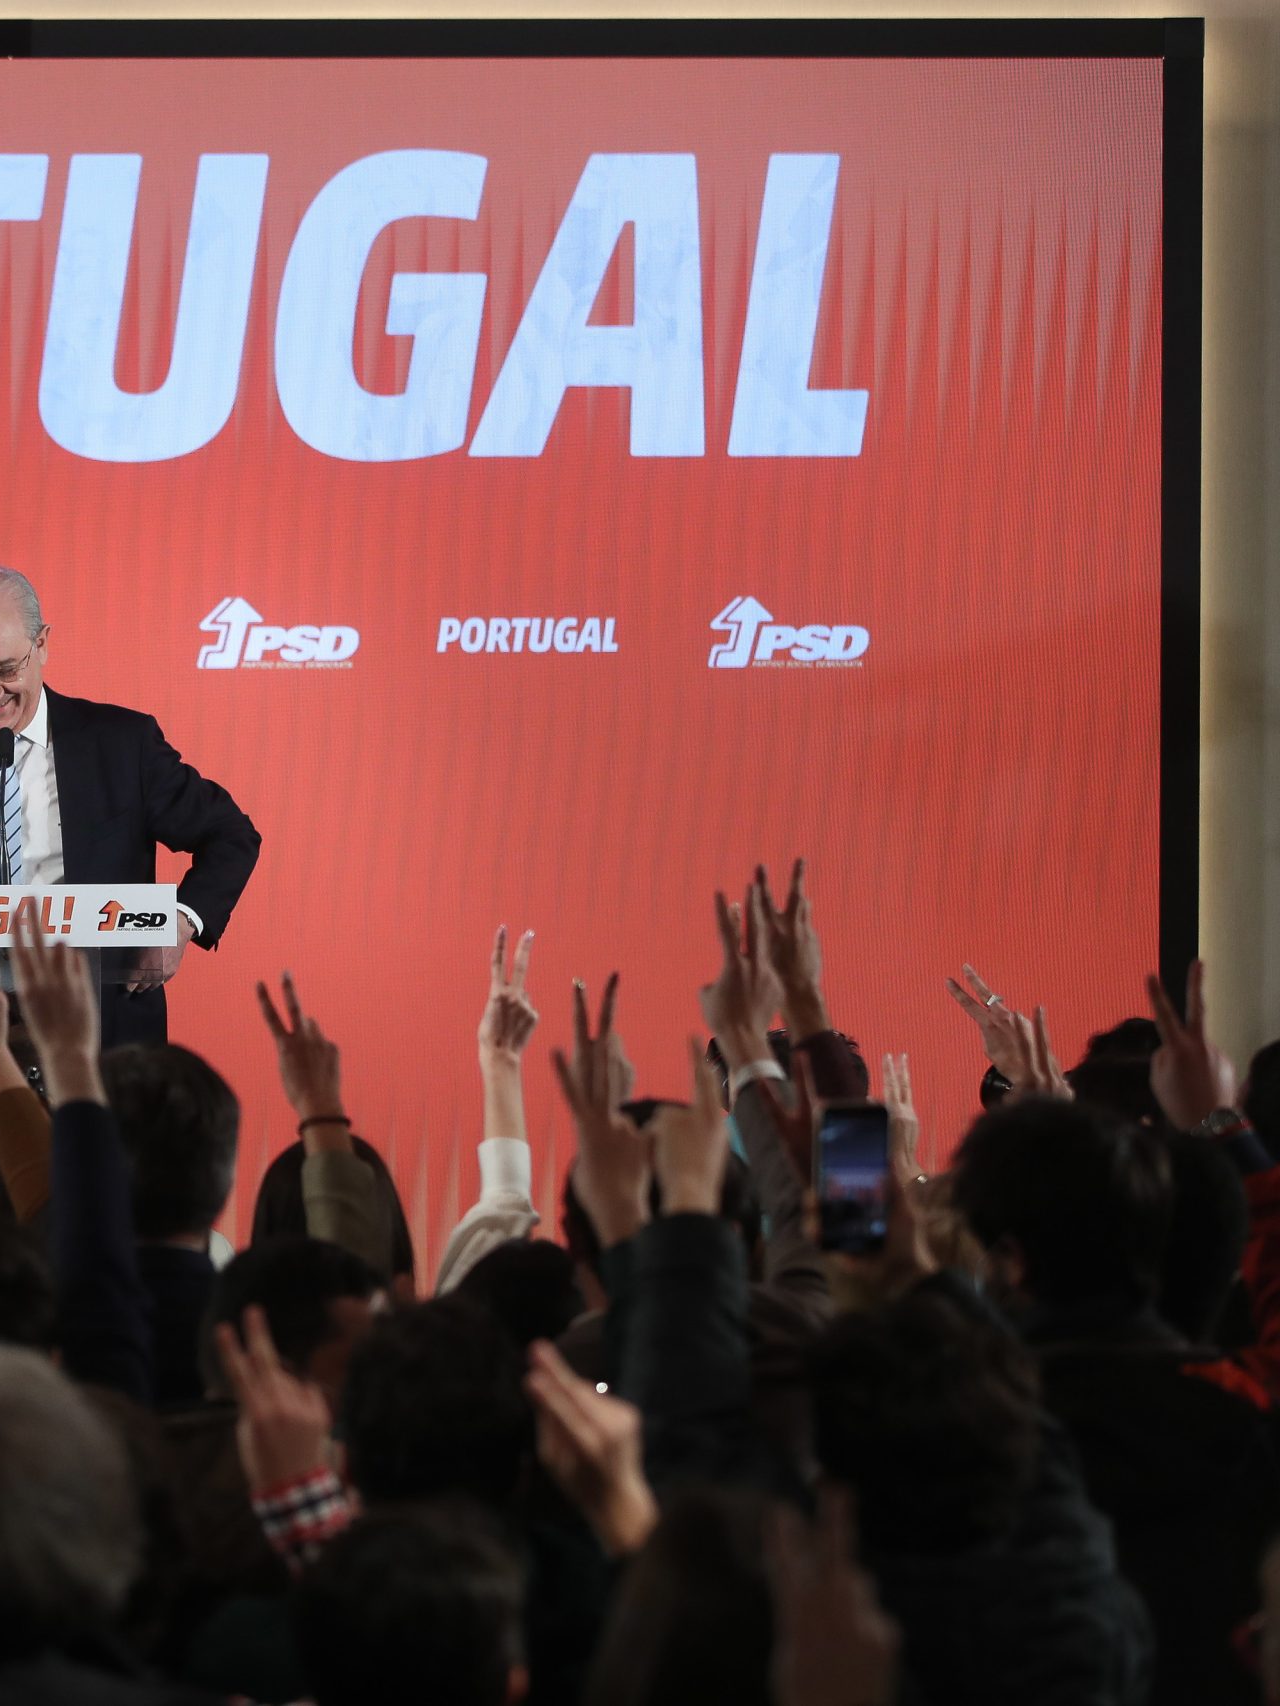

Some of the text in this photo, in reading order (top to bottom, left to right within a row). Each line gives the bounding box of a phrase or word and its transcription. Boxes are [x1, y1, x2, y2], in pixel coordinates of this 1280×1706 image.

[243, 625, 360, 663] PSD
[436, 617, 619, 653] PORTUGAL
[753, 625, 870, 661] PSD
[118, 913, 167, 928] PSD
